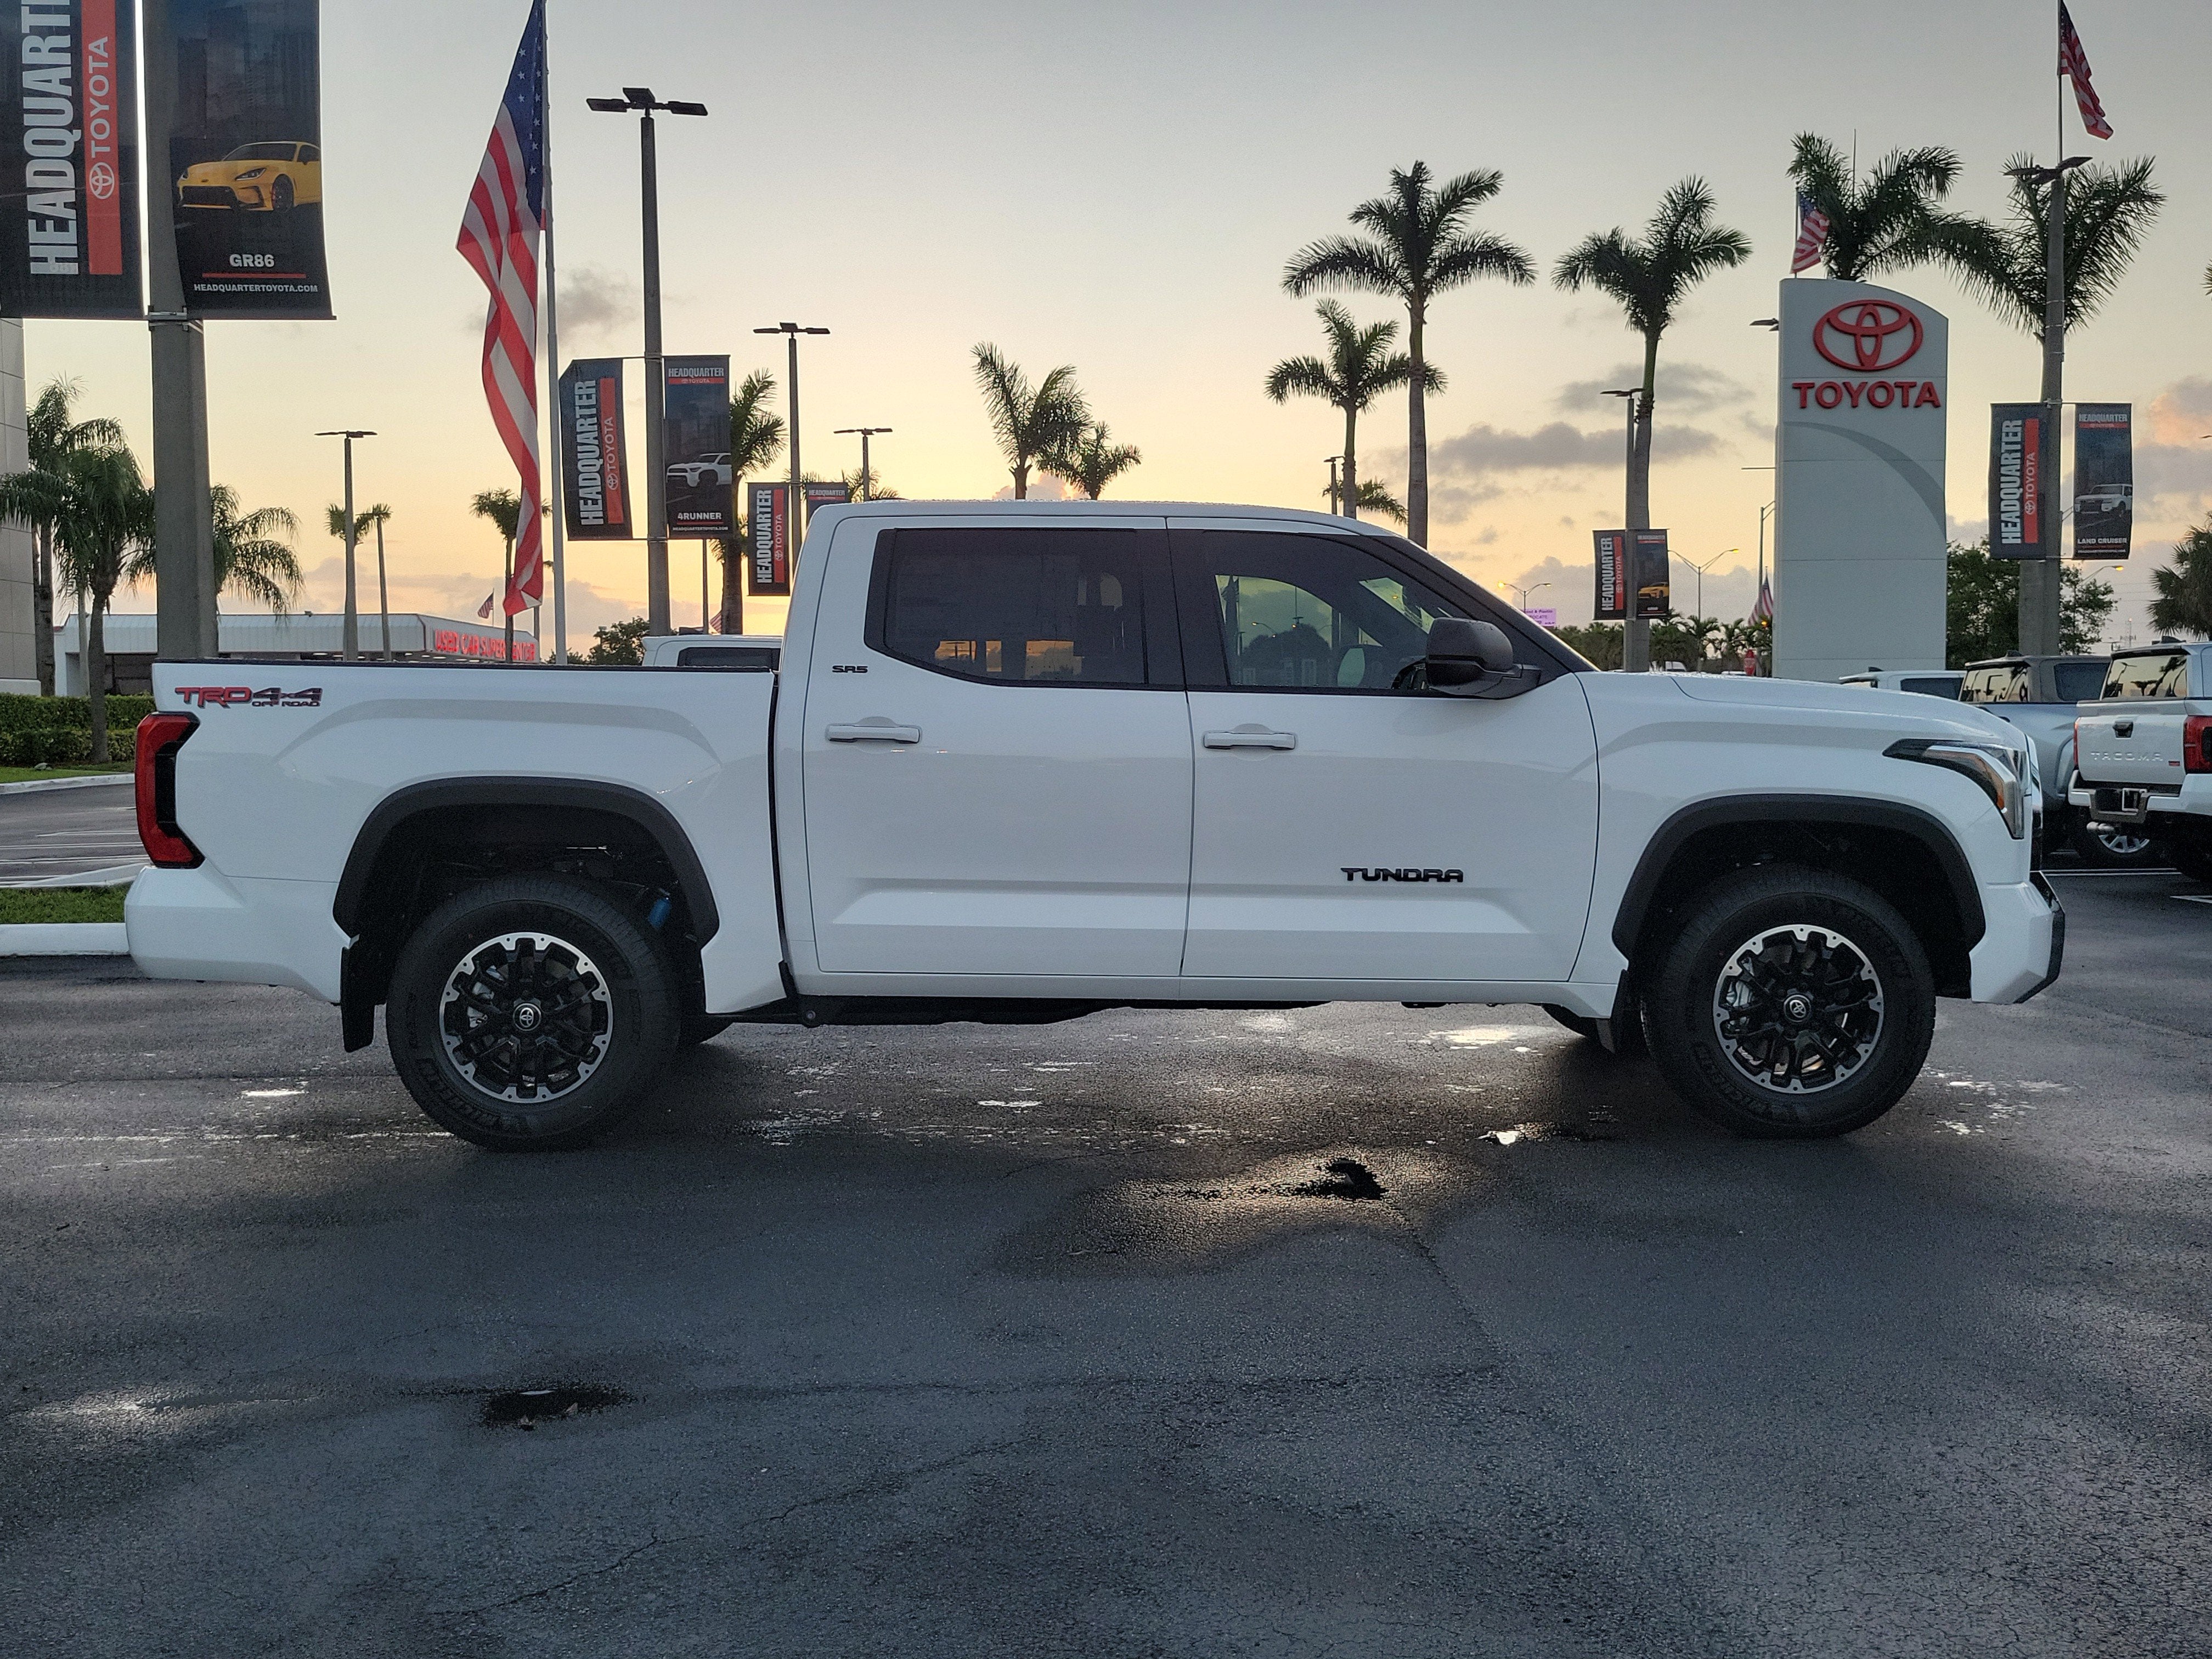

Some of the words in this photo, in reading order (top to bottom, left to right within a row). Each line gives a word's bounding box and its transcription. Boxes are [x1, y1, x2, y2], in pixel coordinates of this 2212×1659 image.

[88, 36, 110, 158] TOYOTA
[21, 0, 81, 274] HEADQUART
[229, 254, 274, 268] GR86
[194, 284, 318, 293] HEADQUARTERTOYOTA.COM
[668, 367, 724, 378] HEADQUARTER
[1792, 381, 1942, 409] TOYOTA
[2078, 413, 2128, 424] HEADQUARTER
[575, 380, 604, 525] HEADQUARTER
[604, 416, 617, 472] TOYOTA
[2000, 420, 2023, 544] HEADQUARTER
[2026, 452, 2036, 499] TOYOTA
[677, 512, 723, 521] 4RUNNER
[756, 489, 774, 583] HEADQUARTER
[1600, 537, 1616, 611] HEADQUARTER
[435, 629, 460, 653] USED
[461, 633, 480, 656] CAR
[512, 641, 536, 661] ENTER
[832, 665, 868, 674] SR5
[174, 687, 253, 709] TRD
[2090, 751, 2164, 761] TACOMA
[1340, 867, 1464, 883] TUNDRA
